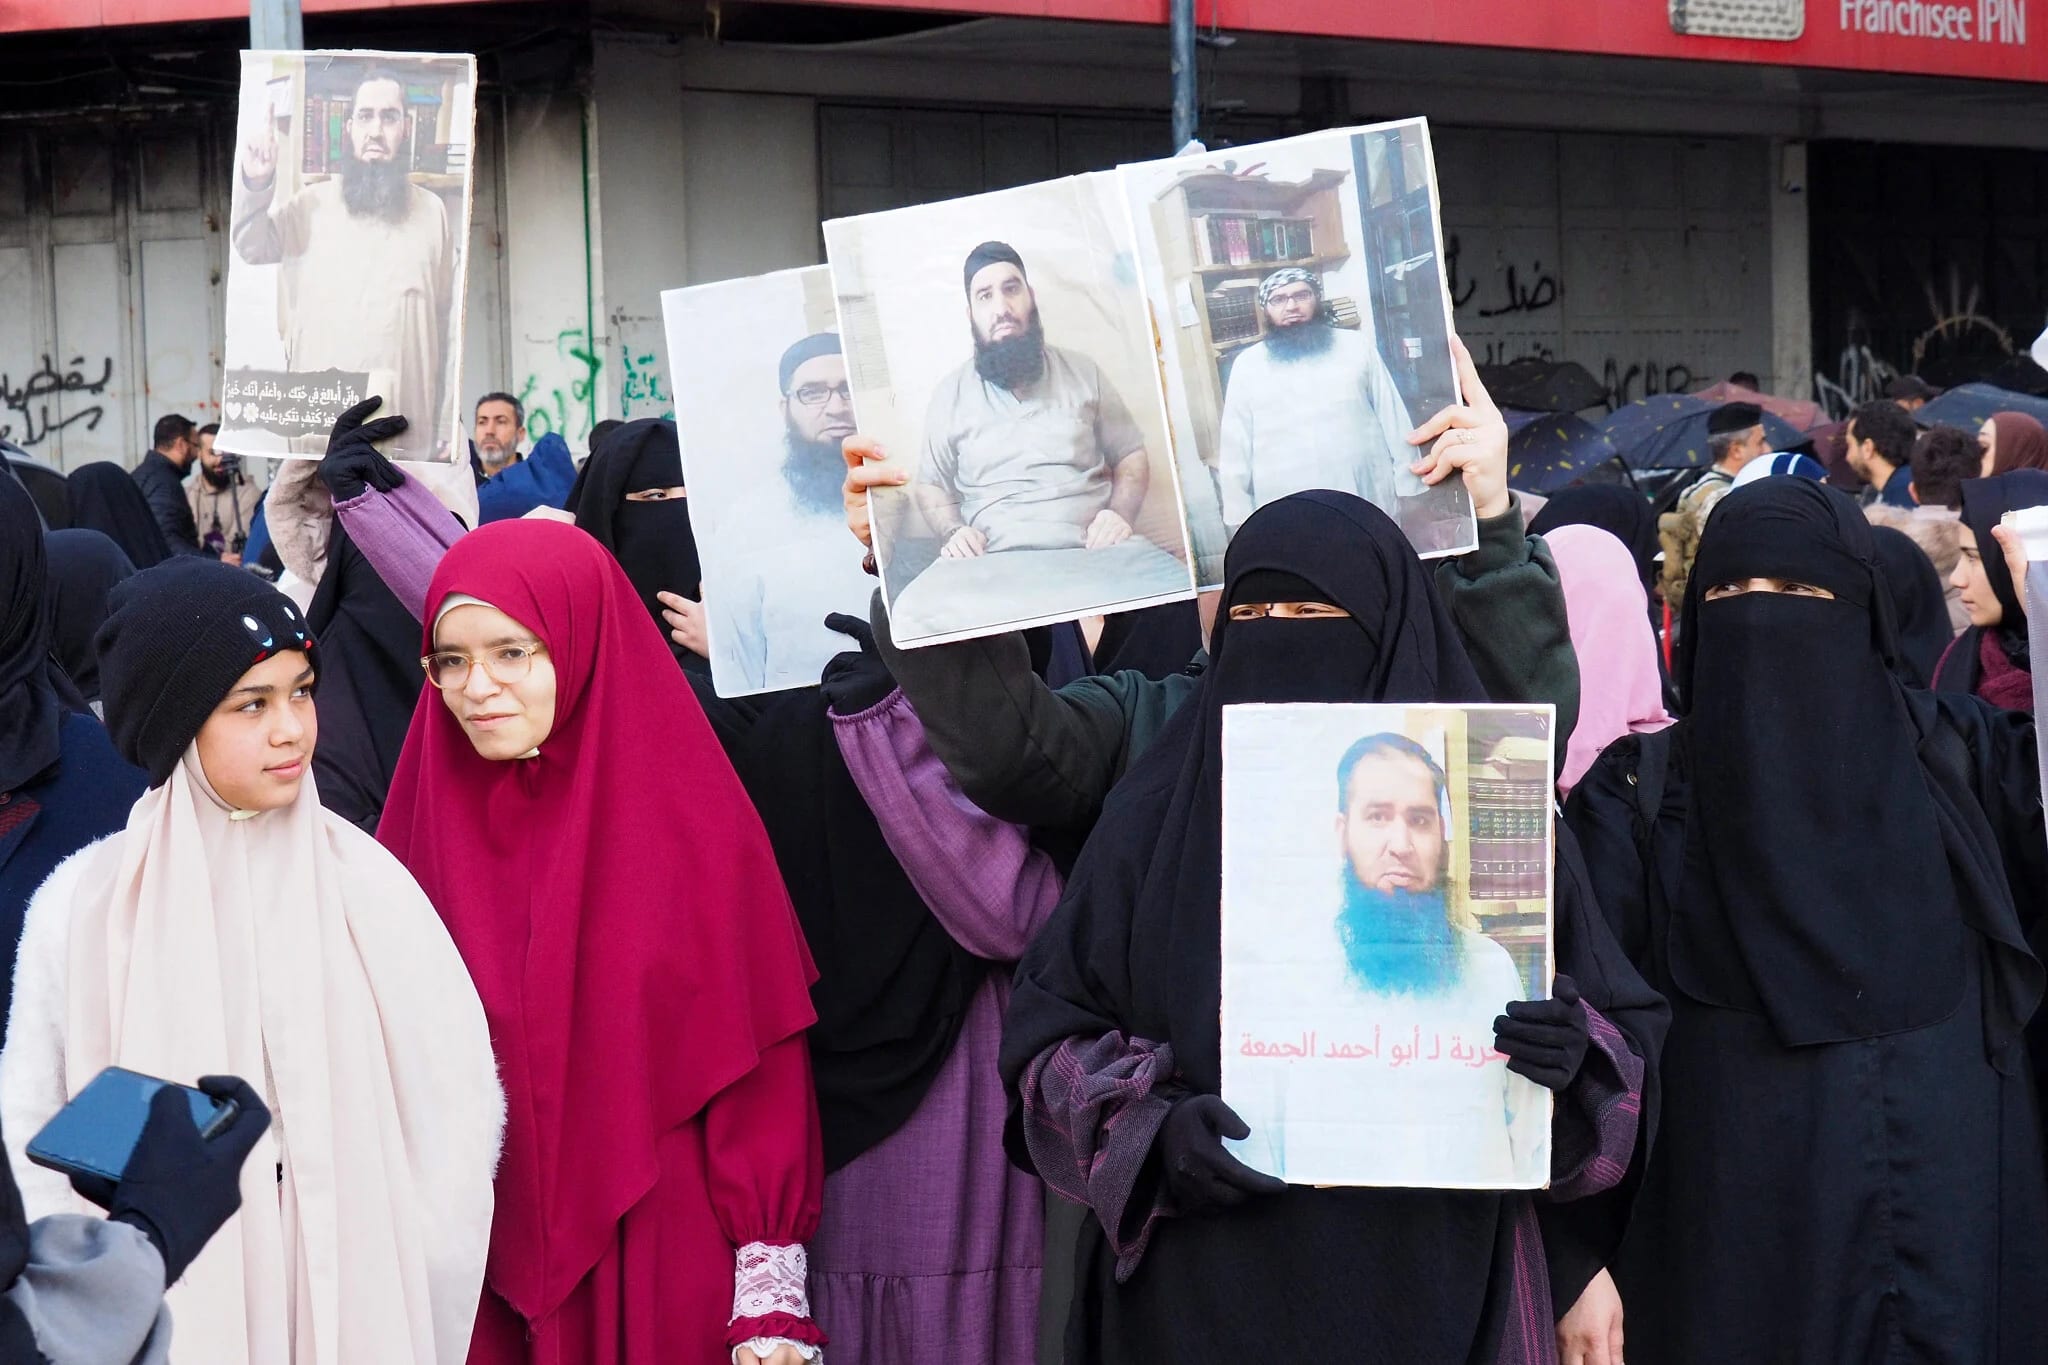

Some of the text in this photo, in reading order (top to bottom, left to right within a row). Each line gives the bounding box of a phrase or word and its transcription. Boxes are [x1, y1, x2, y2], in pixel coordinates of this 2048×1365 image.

[1840, 0, 2027, 45] Franchisee IPIN
[1240, 1030, 1316, 1064] الجمعة
[1323, 1024, 1381, 1060] أحمد
[1389, 1025, 1421, 1067] أبو
